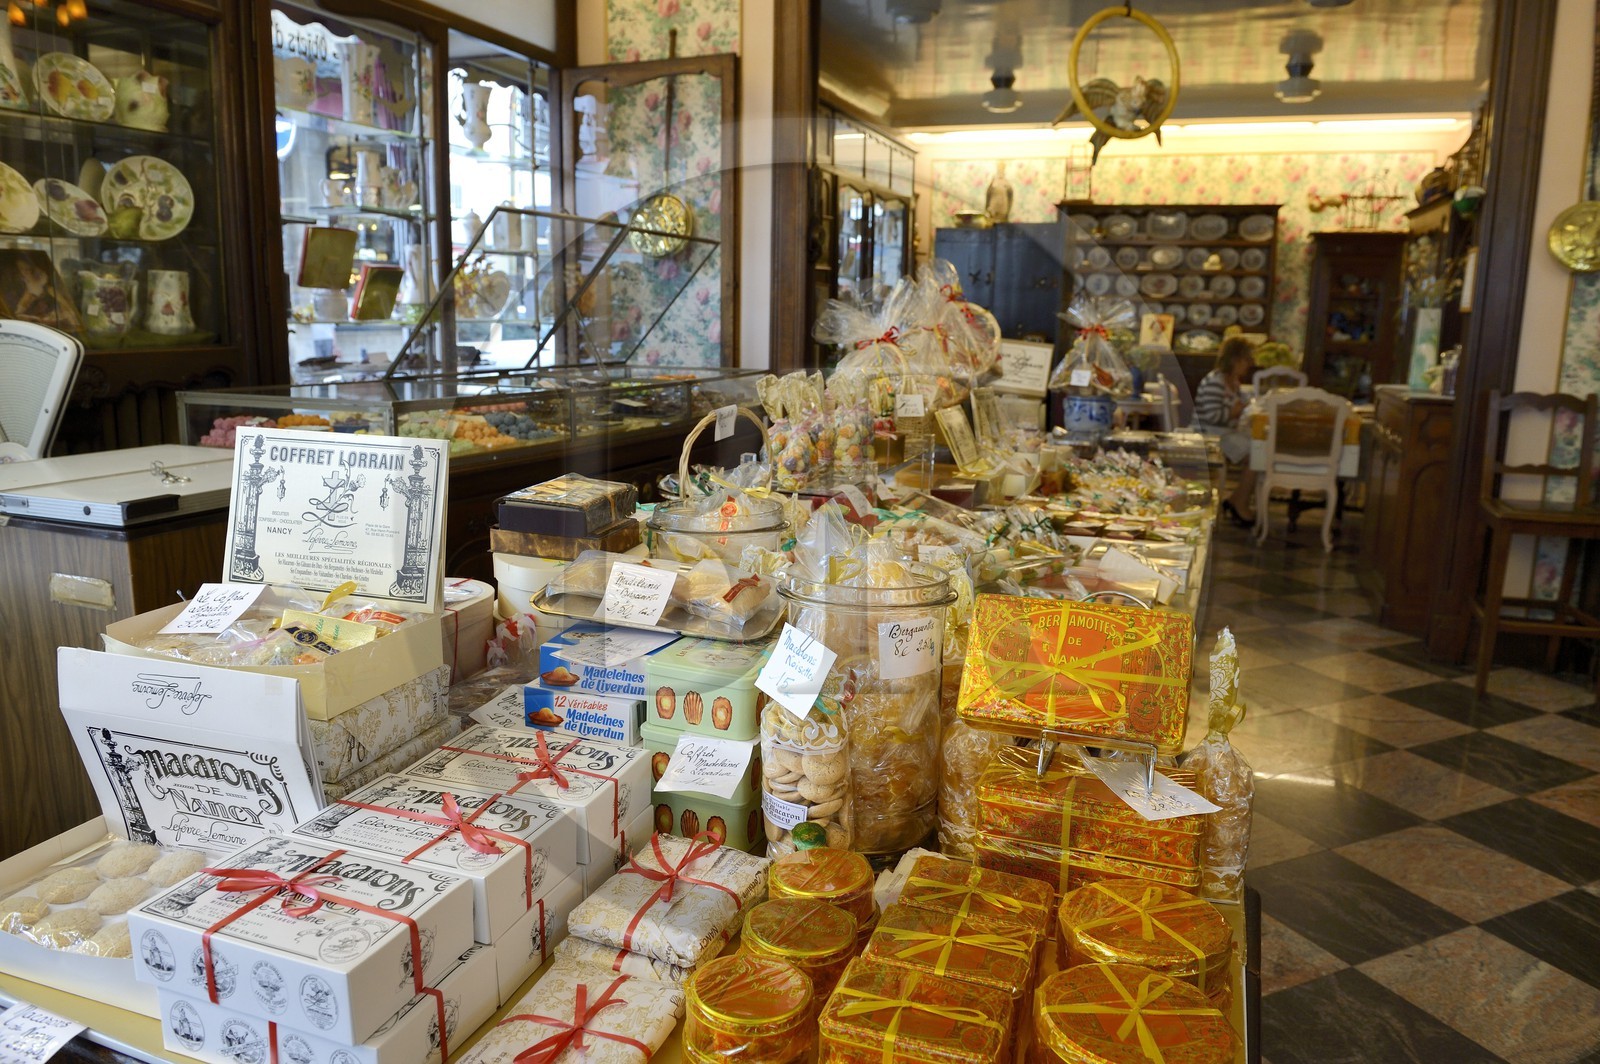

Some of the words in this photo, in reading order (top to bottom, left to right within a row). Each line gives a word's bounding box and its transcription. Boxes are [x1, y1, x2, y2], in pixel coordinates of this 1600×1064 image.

[270, 445, 334, 467] COFFRET
[338, 450, 406, 471] LORRAIN
[266, 526, 293, 535] NANCY
[286, 553, 320, 562] MEILLEURES
[322, 556, 356, 565] SPÉCIALITÉS
[357, 560, 392, 569] RÉGIONALES
[1038, 614, 1117, 637] BERAMOTTES
[783, 629, 817, 666] Macarons
[1067, 636, 1083, 646] DE
[1047, 653, 1098, 669] NANY
[583, 667, 645, 684] Madeleines
[596, 680, 645, 696] Liverdun
[554, 695, 566, 708] 12
[567, 697, 608, 711] Véritables
[565, 709, 625, 729] Madeleines
[578, 722, 625, 741] Liverdun
[680, 742, 717, 763] Coffret
[194, 784, 225, 797] DE
[319, 880, 350, 892] DE
[256, 912, 297, 925] CONFISEUR
[700, 926, 720, 951] NANCY
[750, 982, 785, 996] NANCY
